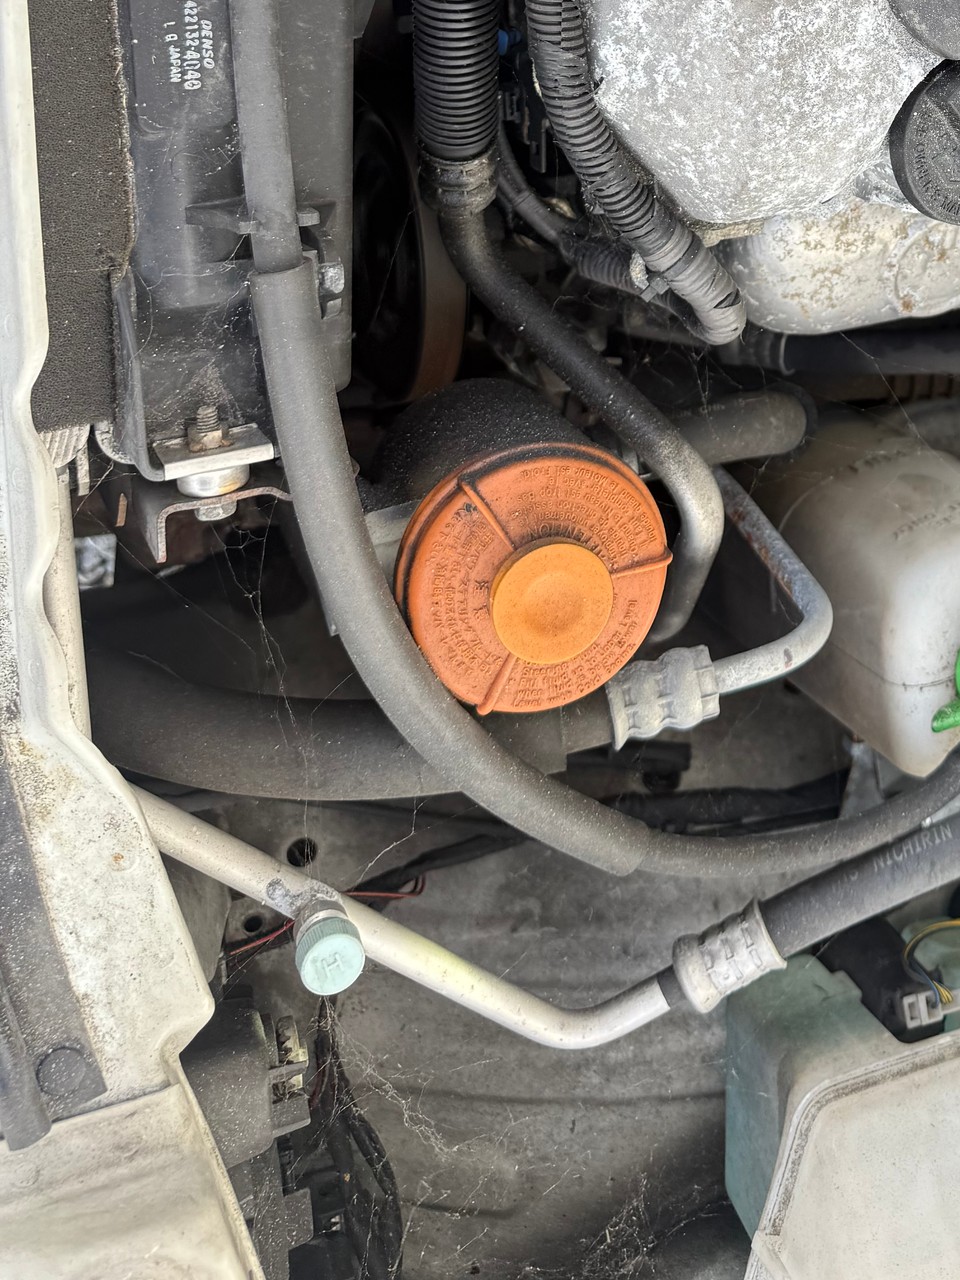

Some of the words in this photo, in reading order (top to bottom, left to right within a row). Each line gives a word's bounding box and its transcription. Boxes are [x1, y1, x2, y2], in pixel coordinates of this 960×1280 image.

[169, 45, 181, 82] JAPAN
[201, 20, 214, 69] DENSO
[873, 825, 954, 871] NICHIRIN
[320, 952, 345, 978] H
